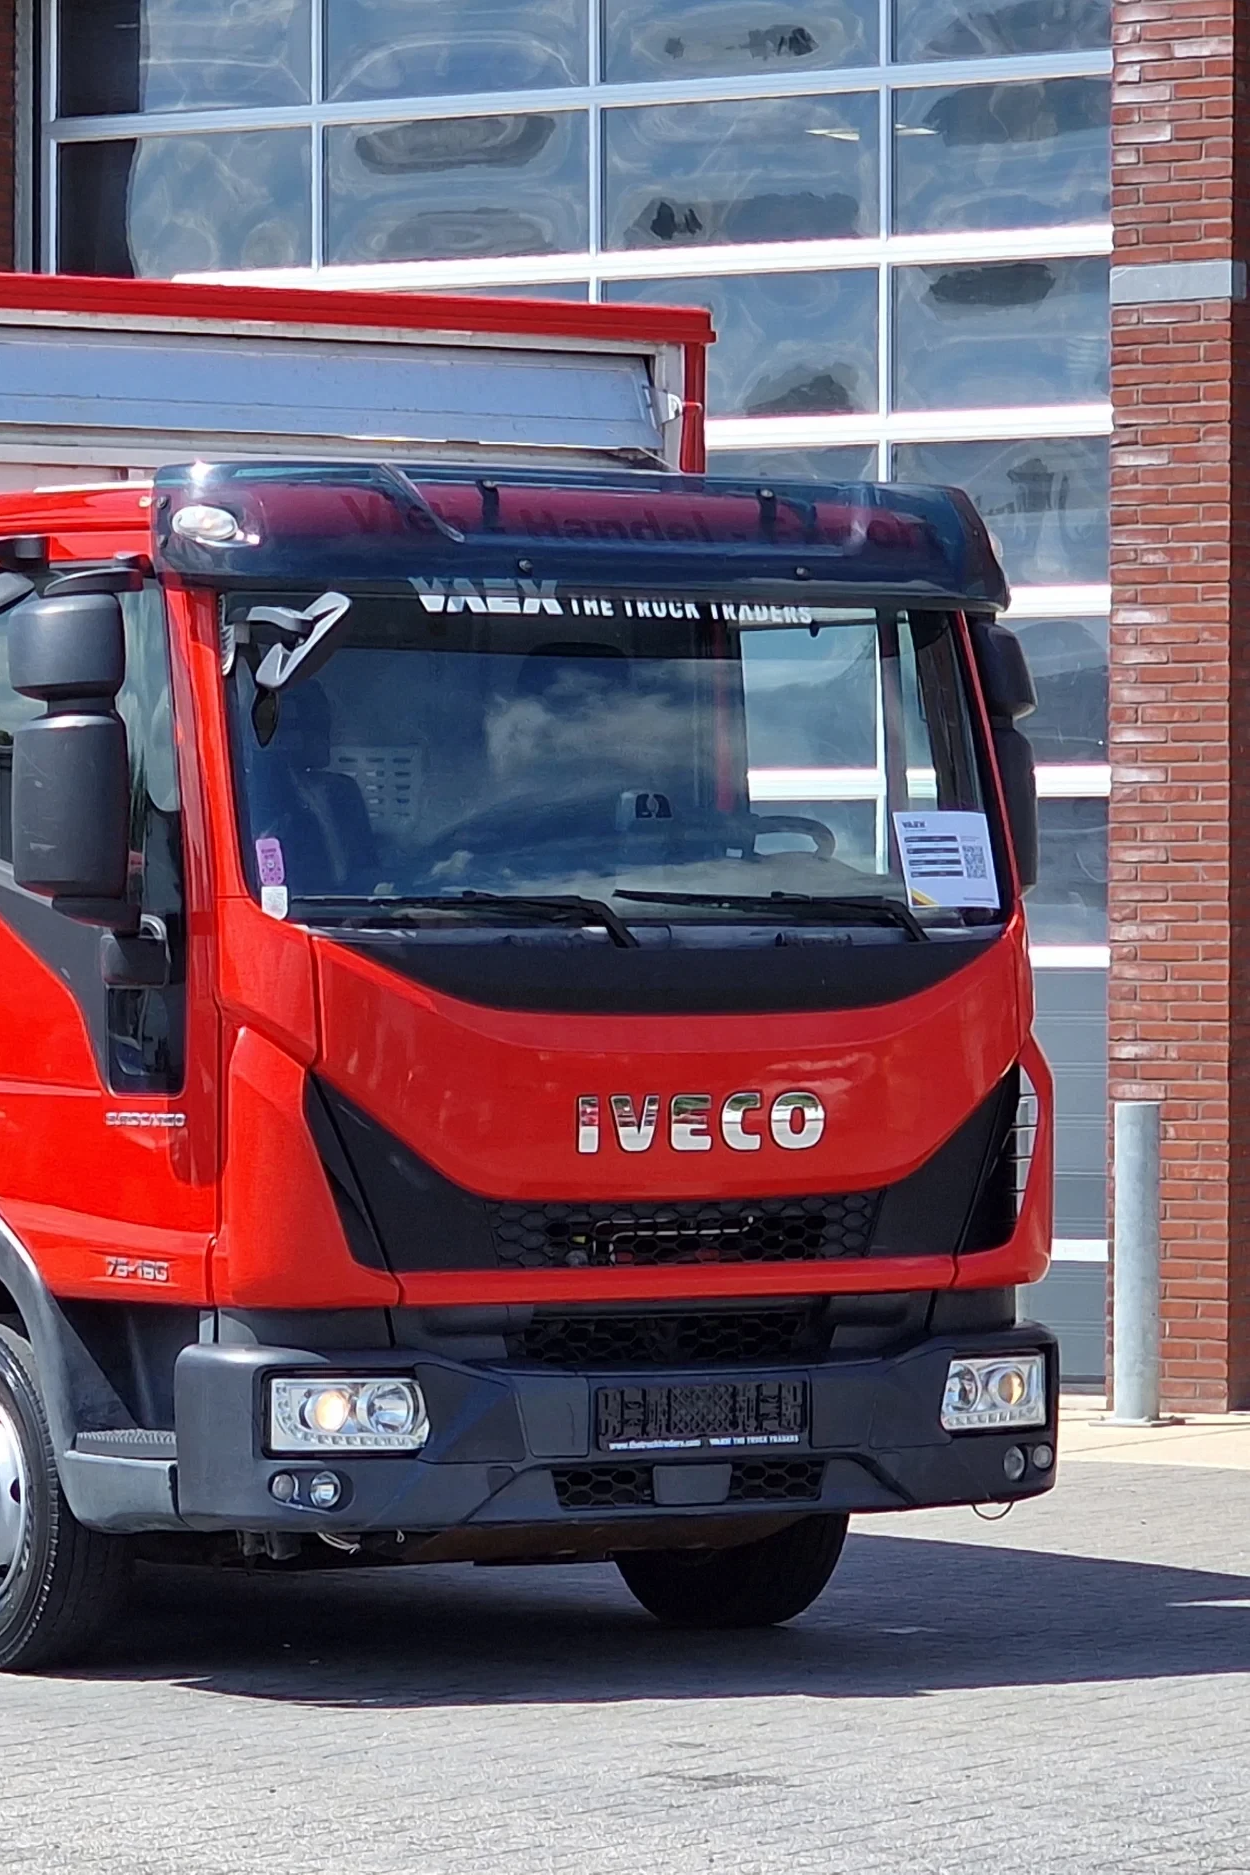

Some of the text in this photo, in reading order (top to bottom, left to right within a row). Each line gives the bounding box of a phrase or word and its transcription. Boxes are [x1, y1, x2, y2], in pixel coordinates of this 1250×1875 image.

[408, 577, 813, 624] VAEX THE TRUCK TRADERS
[578, 1091, 825, 1153] IVECO
